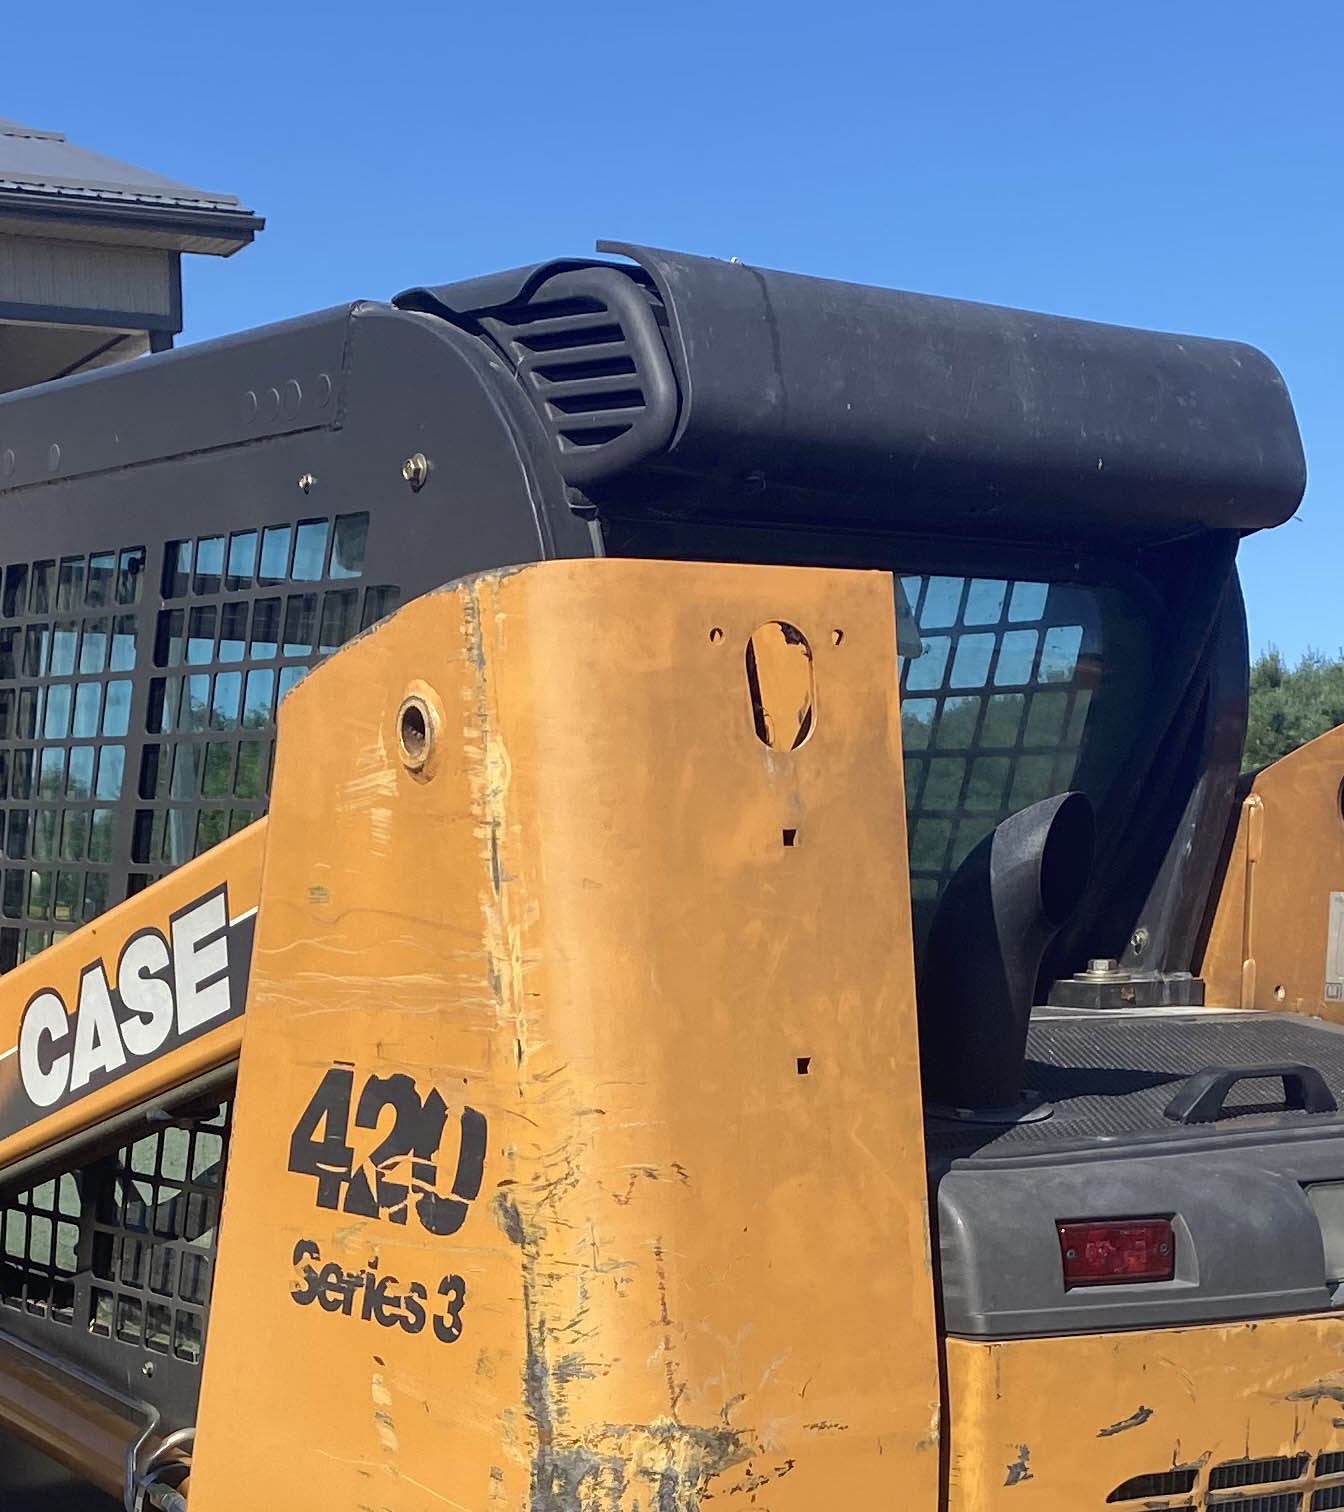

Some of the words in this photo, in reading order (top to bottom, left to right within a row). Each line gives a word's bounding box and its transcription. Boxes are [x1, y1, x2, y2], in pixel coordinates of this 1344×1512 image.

[18, 890, 231, 1108] CASE
[287, 1066, 488, 1236] 420
[289, 1237, 428, 1334] Series
[432, 1273, 467, 1344] 3
